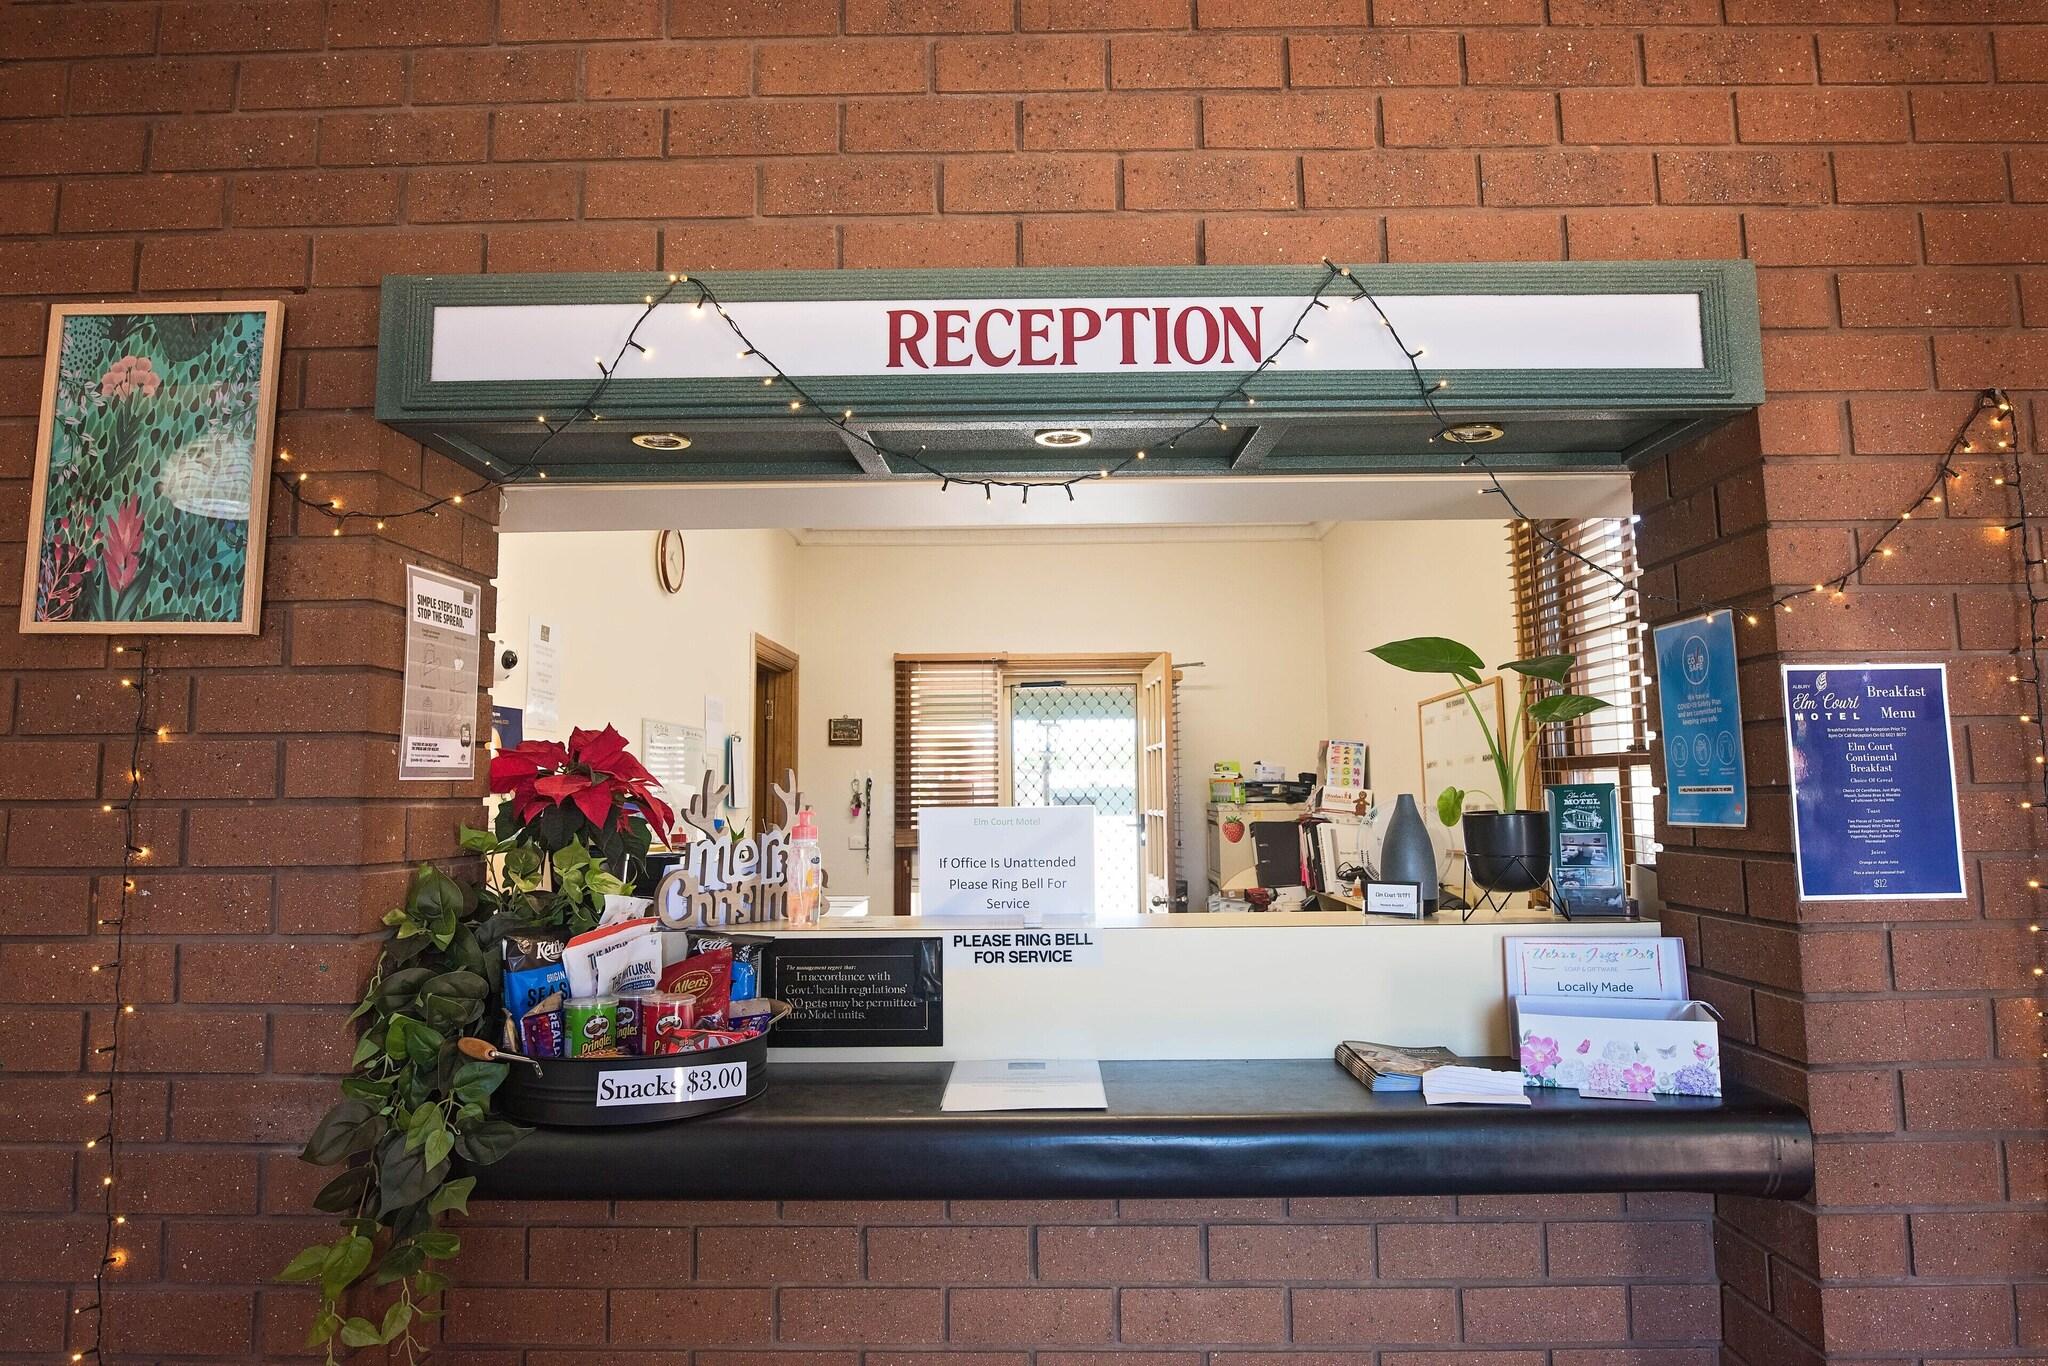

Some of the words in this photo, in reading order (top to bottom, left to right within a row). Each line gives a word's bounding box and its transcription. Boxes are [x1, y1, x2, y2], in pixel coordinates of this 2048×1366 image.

[886, 306, 1264, 369] RECEPTION
[417, 594, 437, 609] SIMPLE
[438, 600, 453, 613] STEPS
[454, 604, 460, 616] TO
[461, 606, 474, 618] HELP
[418, 607, 431, 620] STOP
[432, 610, 442, 623] THE
[443, 613, 465, 629] SPREAD.
[1689, 662, 1704, 672] SAFE
[1867, 685, 1926, 698] Breakfast
[1793, 693, 1817, 710] Elm
[1822, 693, 1860, 710] Court
[1794, 712, 1860, 720] MOTEL
[1880, 706, 1916, 719] Menu
[1848, 742, 1866, 751] Elm
[1868, 742, 1893, 751] Court
[1846, 752, 1898, 762] Continental
[1850, 763, 1892, 772] Breakfast
[1564, 798, 1600, 806] MOTEL
[974, 818, 988, 826] Elm
[991, 818, 1014, 826] Court
[1016, 818, 1040, 826] Motel
[939, 858, 948, 868] If
[951, 858, 986, 868] Office
[991, 858, 1000, 868] Is
[1004, 856, 1076, 868] Unattended
[949, 878, 988, 890] Please
[992, 878, 1018, 892] Ring
[1022, 878, 1044, 889] Bell
[1048, 878, 1067, 888] For
[1874, 878, 1888, 888] $12
[986, 898, 1030, 909] Service
[953, 934, 1012, 947] PLEASE
[1016, 934, 1051, 946] RING
[1055, 932, 1093, 946] BELL
[536, 940, 564, 961] Kettle
[974, 952, 1004, 964] FOR
[1008, 950, 1073, 963] SERVICE
[547, 970, 566, 983] ORIGIN
[796, 972, 808, 982] In
[808, 972, 866, 982] accordance
[868, 971, 890, 980] with
[674, 976, 708, 994] Allen's
[1557, 980, 1598, 994] Locally
[1602, 982, 1634, 993] Made
[786, 998, 804, 1008] NO
[805, 999, 828, 1010] pets
[829, 1000, 850, 1010] may
[852, 998, 864, 1008] be
[808, 1010, 836, 1020] Motel
[838, 1010, 866, 1020] units.
[617, 1024, 638, 1038] ingles
[582, 1034, 612, 1056] Pringles
[600, 1075, 678, 1101] Snacks
[686, 1066, 742, 1095] $3.00
